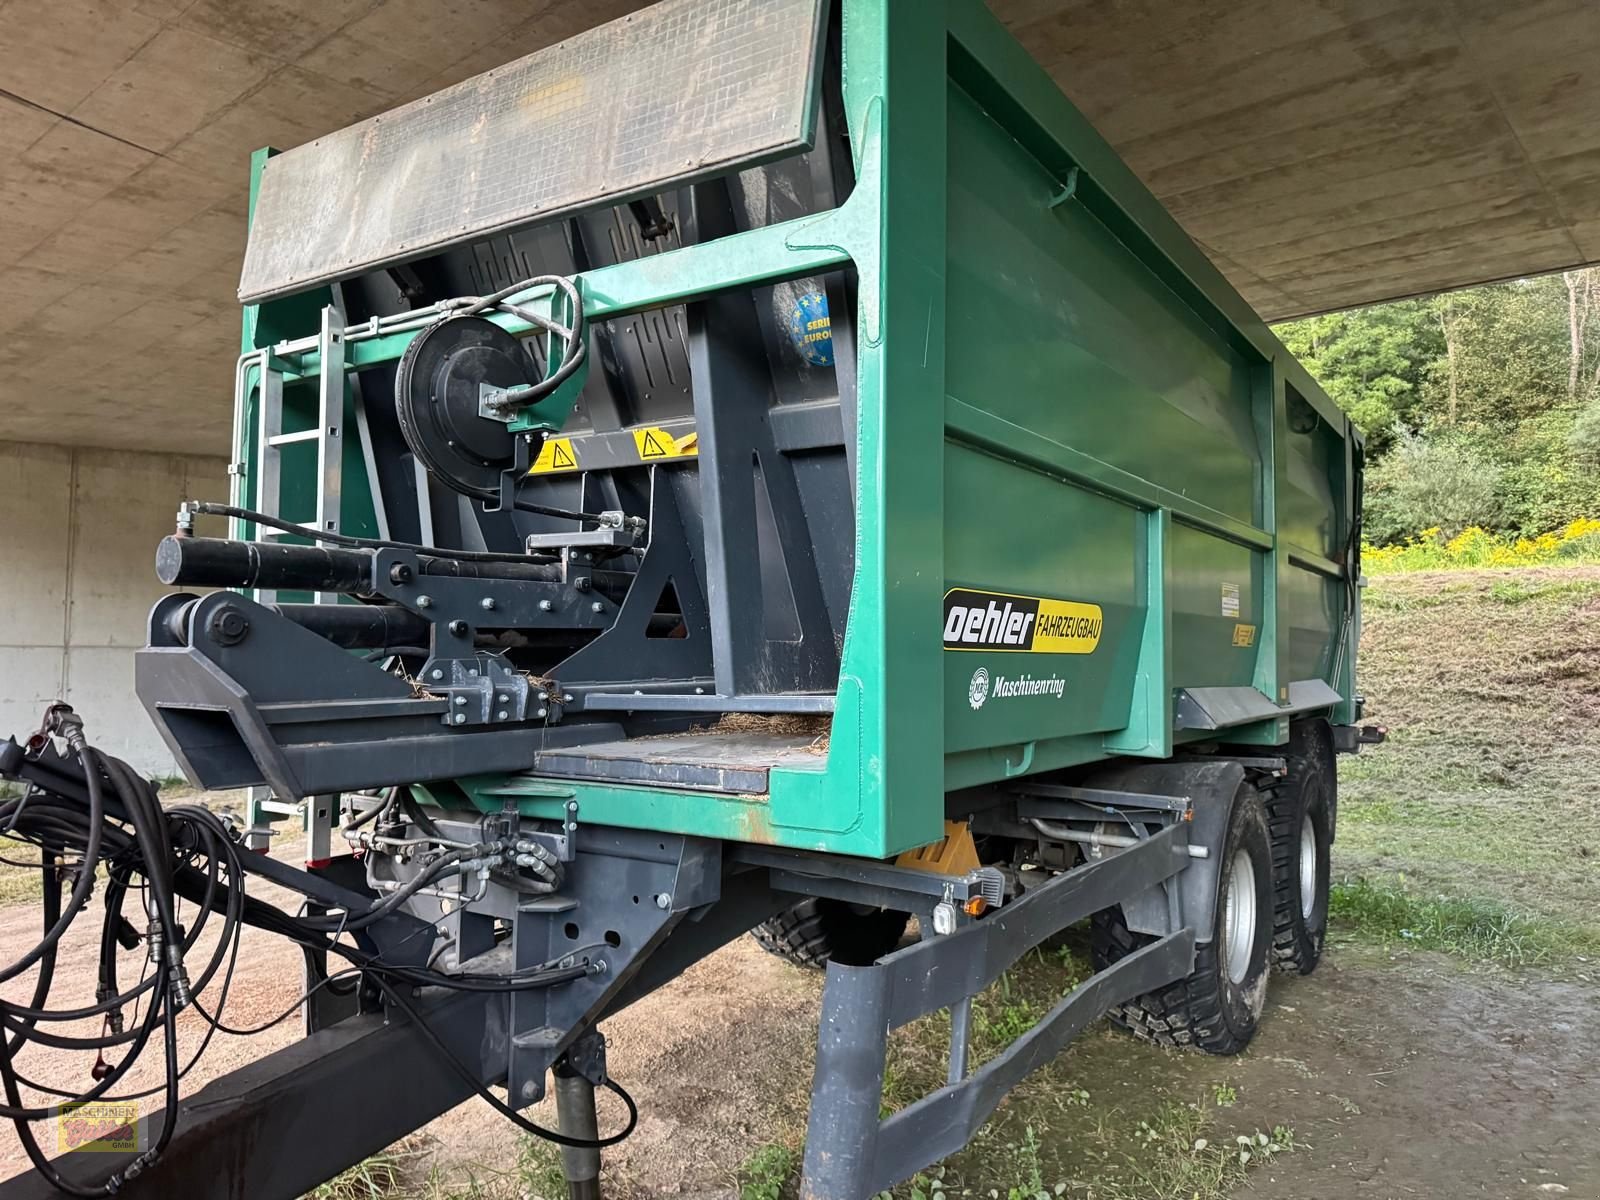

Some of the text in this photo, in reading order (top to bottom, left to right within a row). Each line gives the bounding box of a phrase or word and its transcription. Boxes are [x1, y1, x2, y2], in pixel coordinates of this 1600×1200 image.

[943, 600, 1102, 645] oehler FAHRZEUGBAU
[992, 673, 1066, 699] Maschinenring
